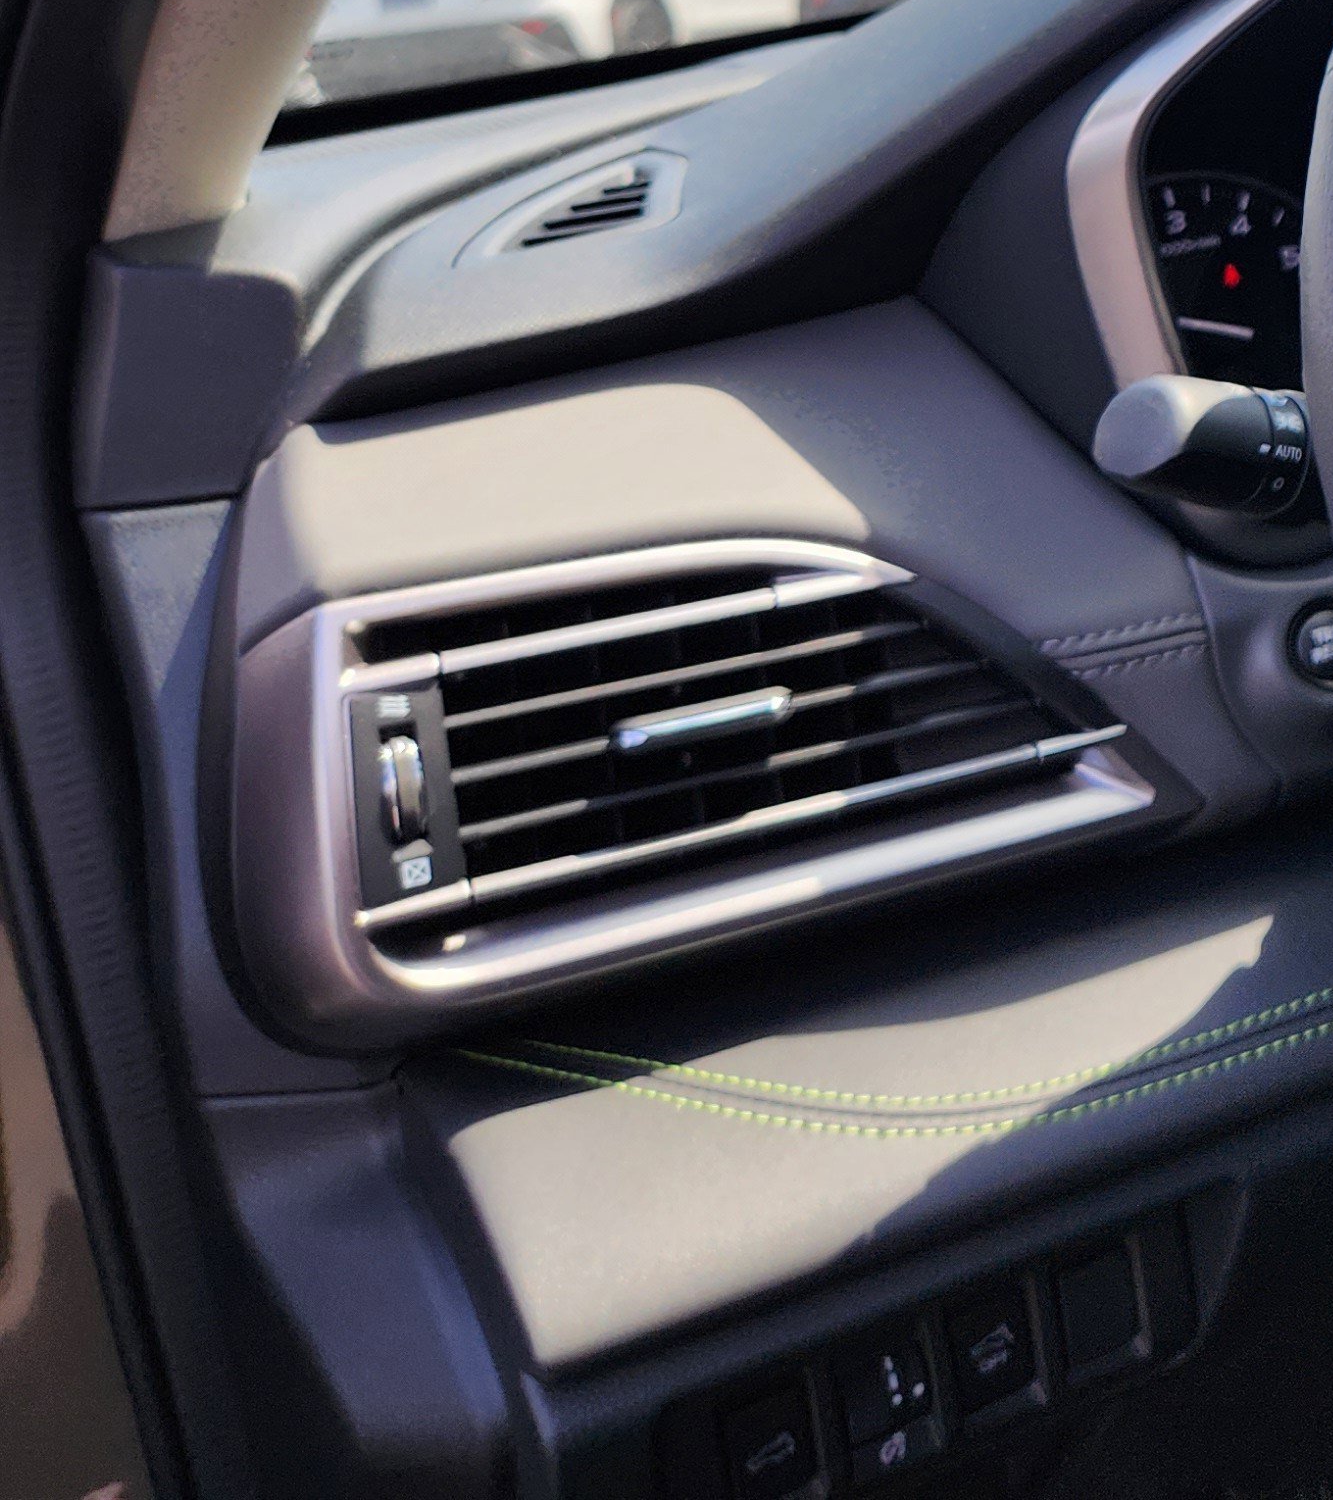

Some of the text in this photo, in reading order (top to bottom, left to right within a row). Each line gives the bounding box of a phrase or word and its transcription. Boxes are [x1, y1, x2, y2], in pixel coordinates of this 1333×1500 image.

[1164, 208, 1187, 236] 3
[1228, 213, 1252, 236] 4
[1275, 444, 1302, 460] AUTO
